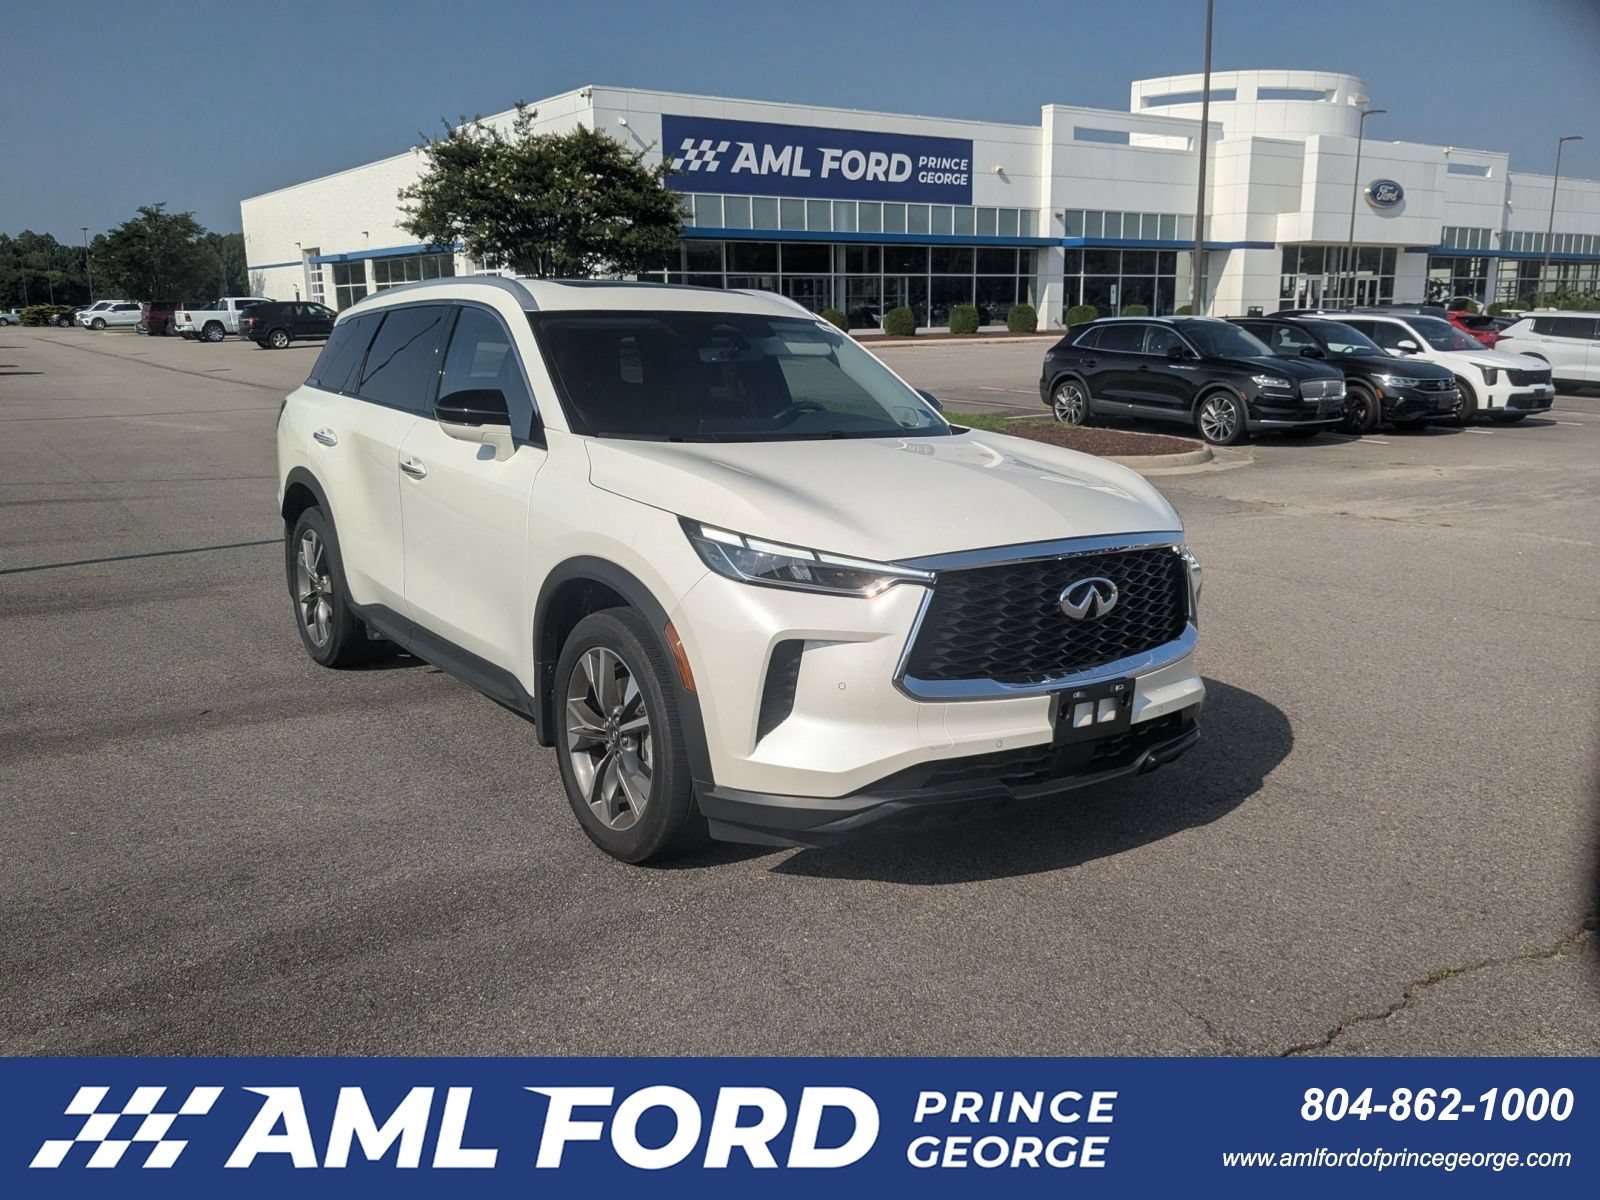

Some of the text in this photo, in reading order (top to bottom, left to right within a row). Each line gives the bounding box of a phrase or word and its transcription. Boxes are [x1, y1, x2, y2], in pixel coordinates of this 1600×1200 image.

[730, 141, 913, 183] AML FORD
[918, 156, 969, 171] PRINCE
[918, 171, 968, 186] GEORGE
[1376, 185, 1399, 201] Ford
